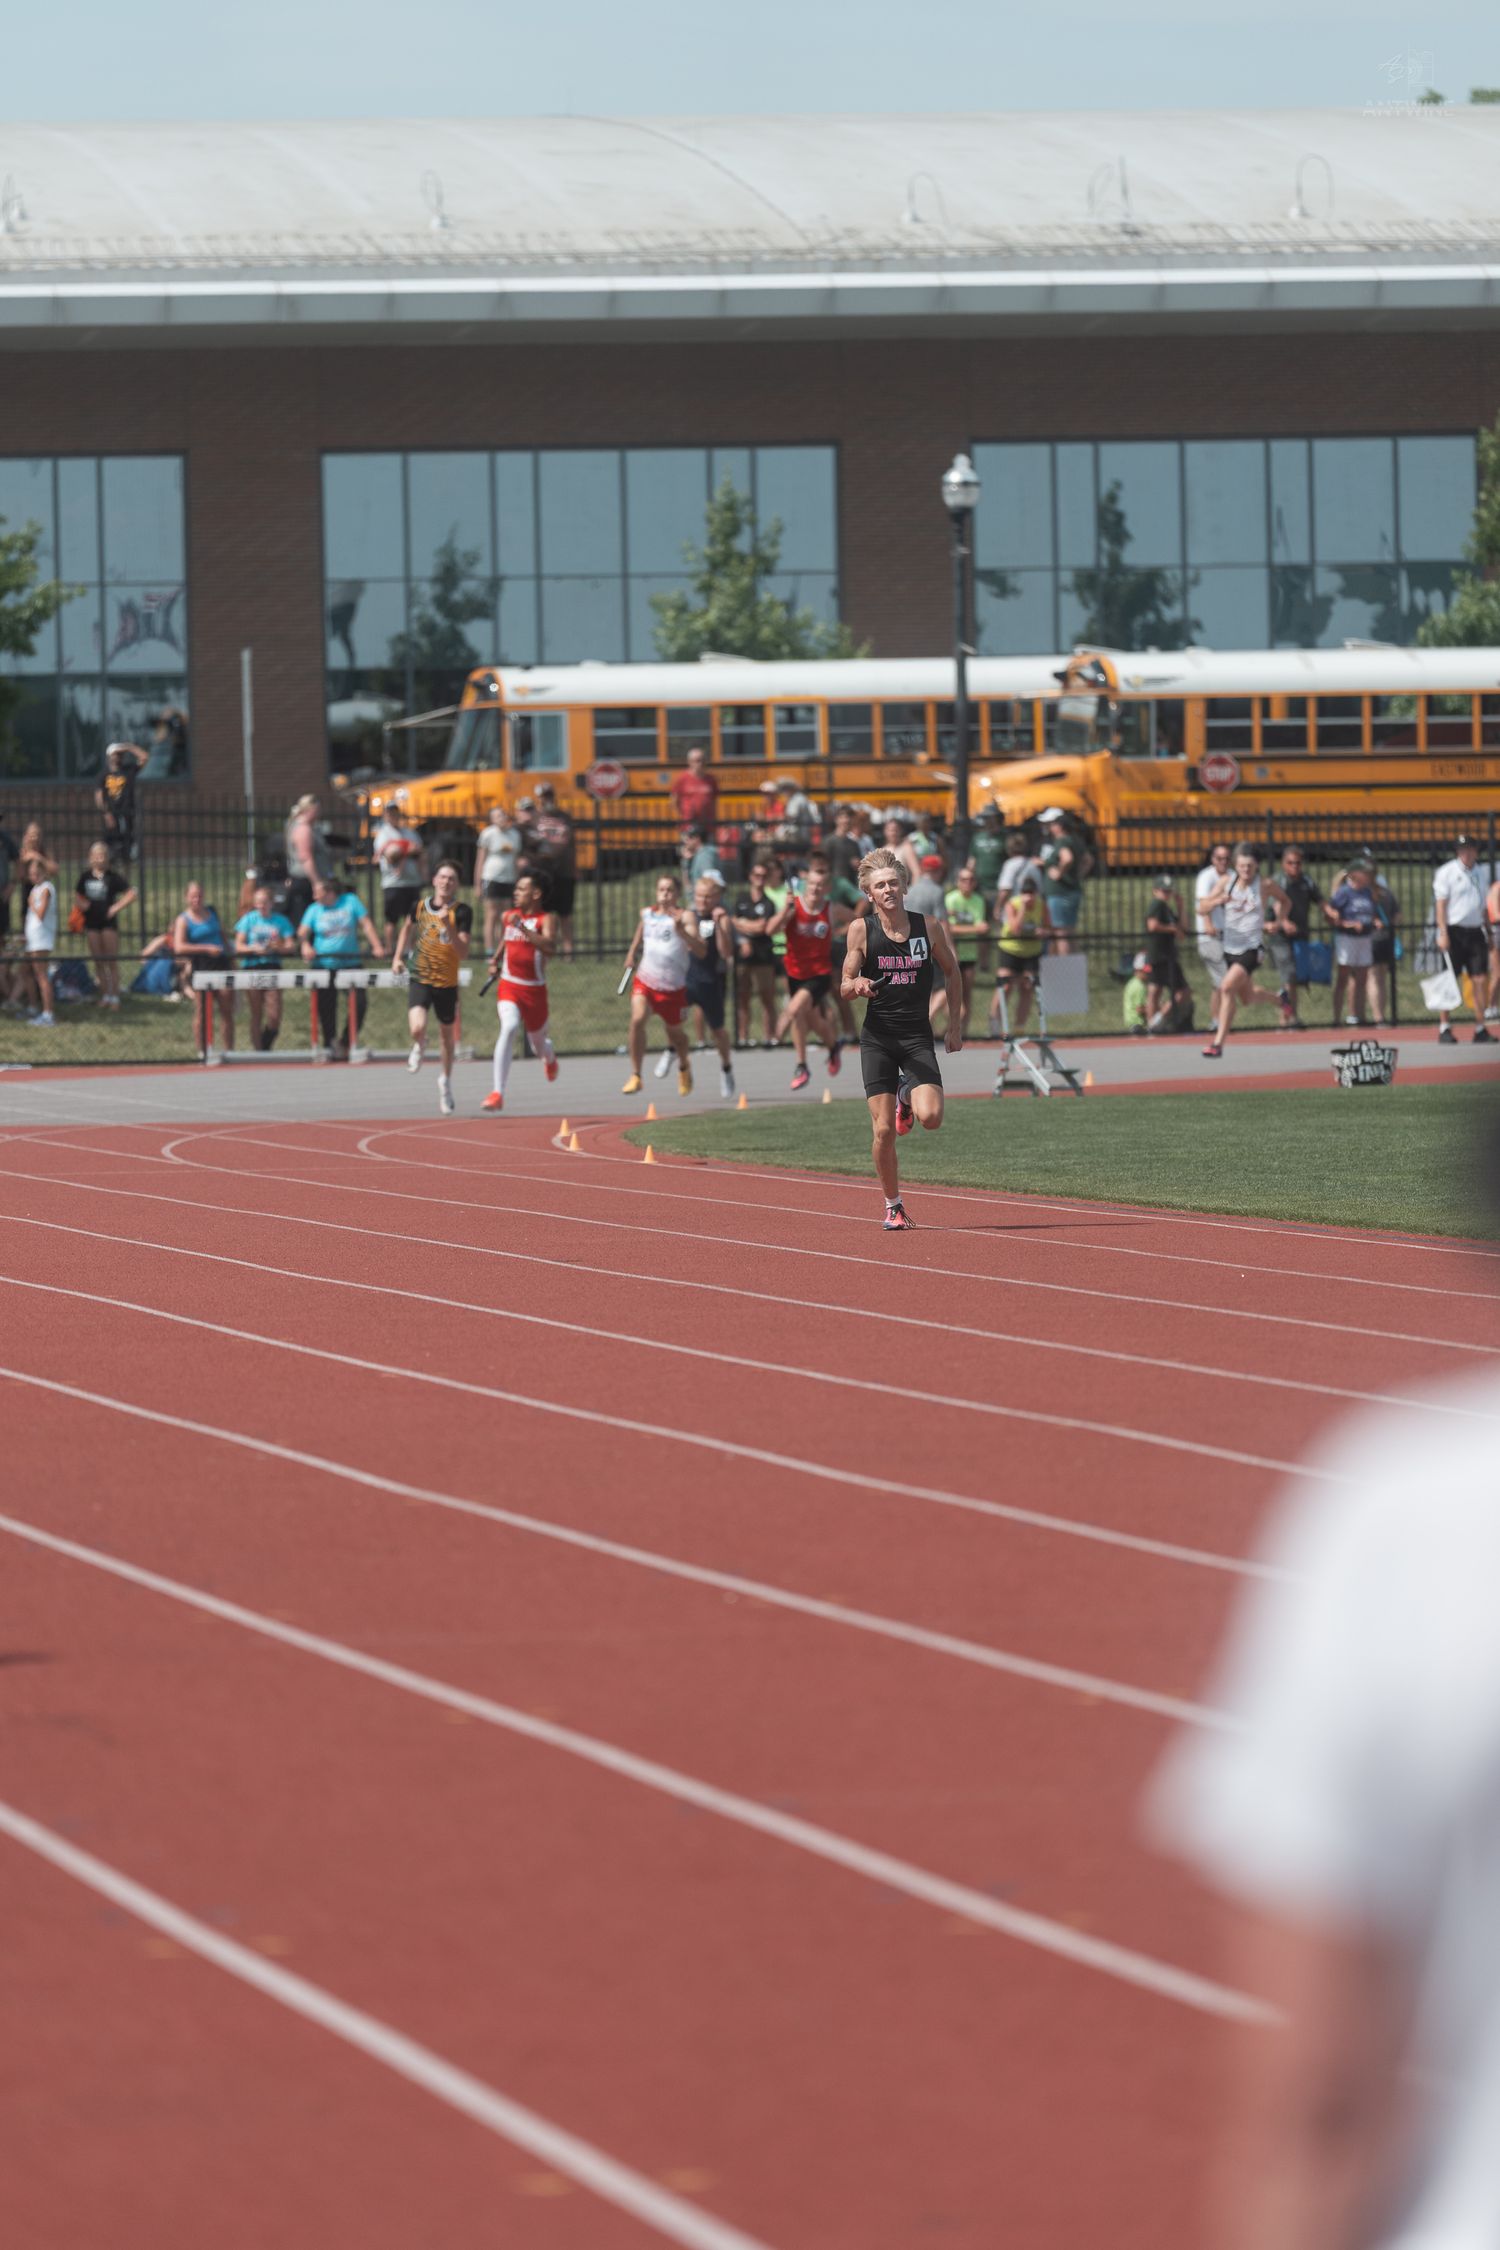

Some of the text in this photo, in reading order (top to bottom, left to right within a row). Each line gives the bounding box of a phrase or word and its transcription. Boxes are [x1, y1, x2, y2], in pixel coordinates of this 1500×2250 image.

[593, 773, 620, 787] STOP
[1206, 767, 1233, 782] STOP
[913, 939, 926, 959] 4
